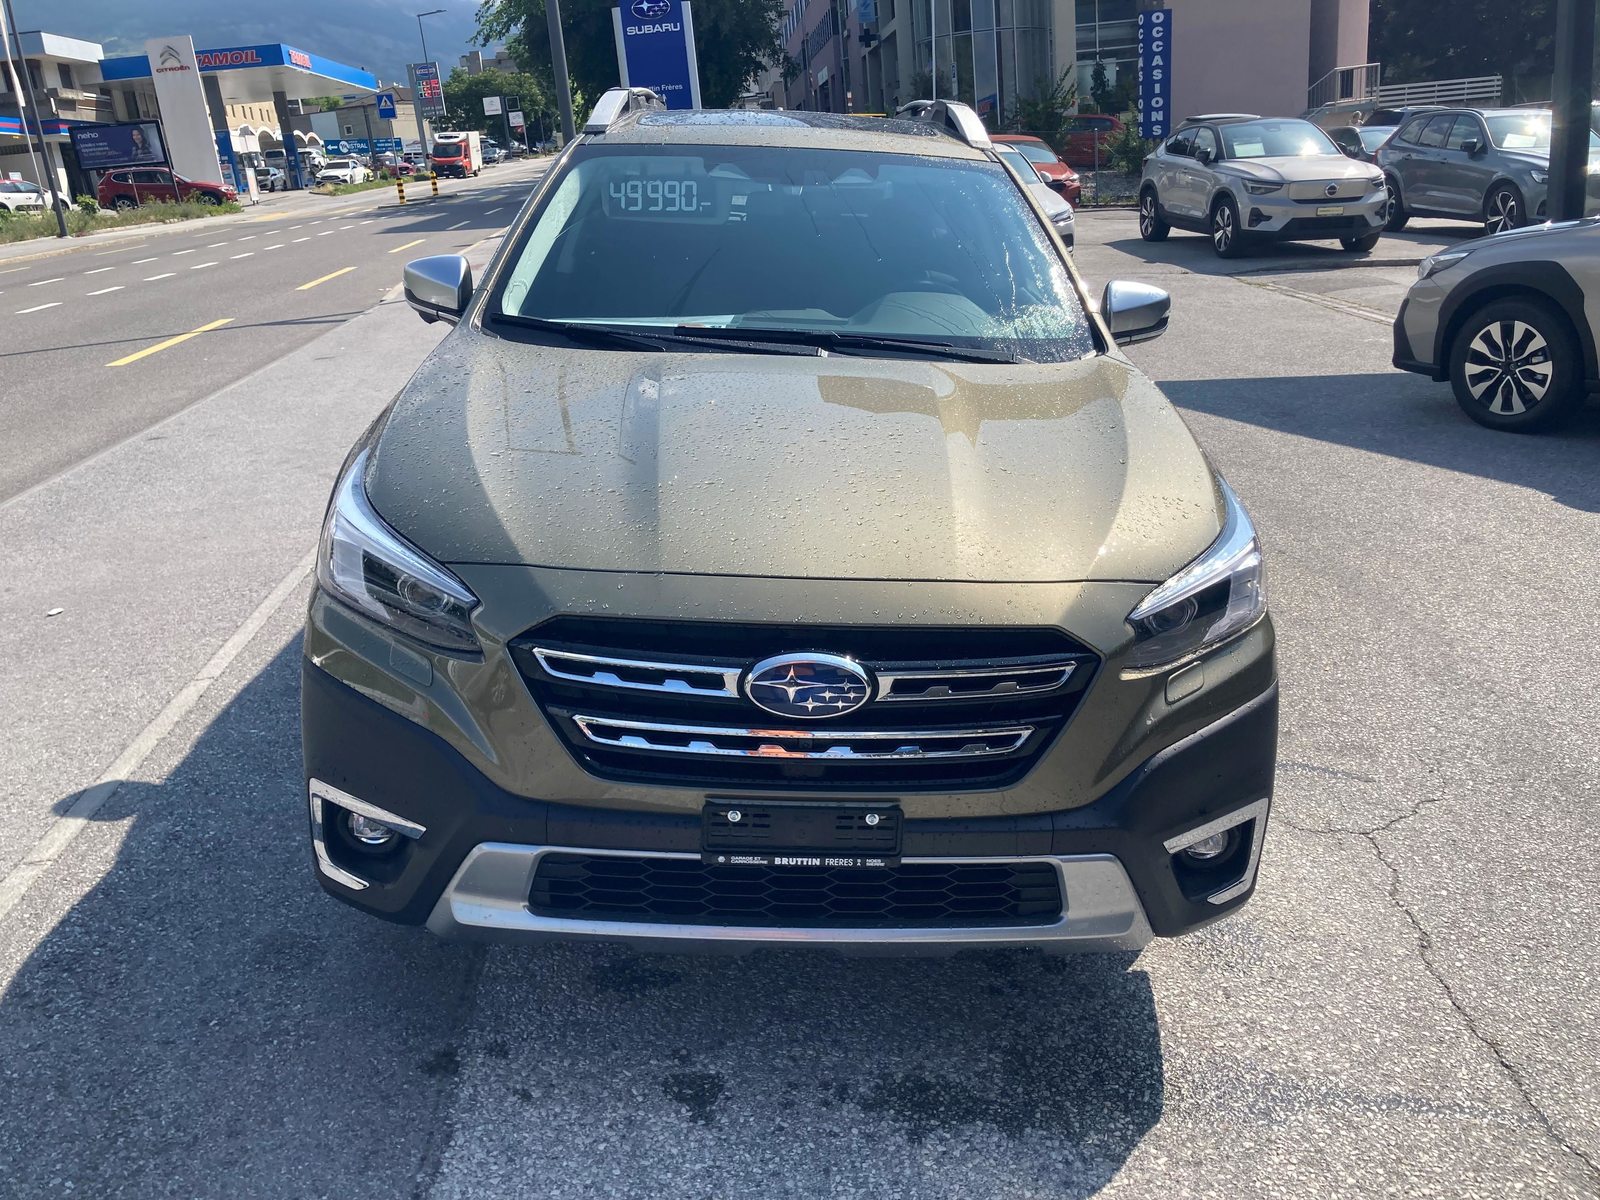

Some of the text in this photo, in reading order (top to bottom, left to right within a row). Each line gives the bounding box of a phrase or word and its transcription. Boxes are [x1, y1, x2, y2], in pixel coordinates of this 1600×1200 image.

[626, 22, 680, 35] SUBARU
[1151, 12, 1164, 136] OCCASIONS
[661, 83, 683, 91] Frères
[77, 131, 99, 140] neho
[774, 857, 820, 866] BRUTTIN
